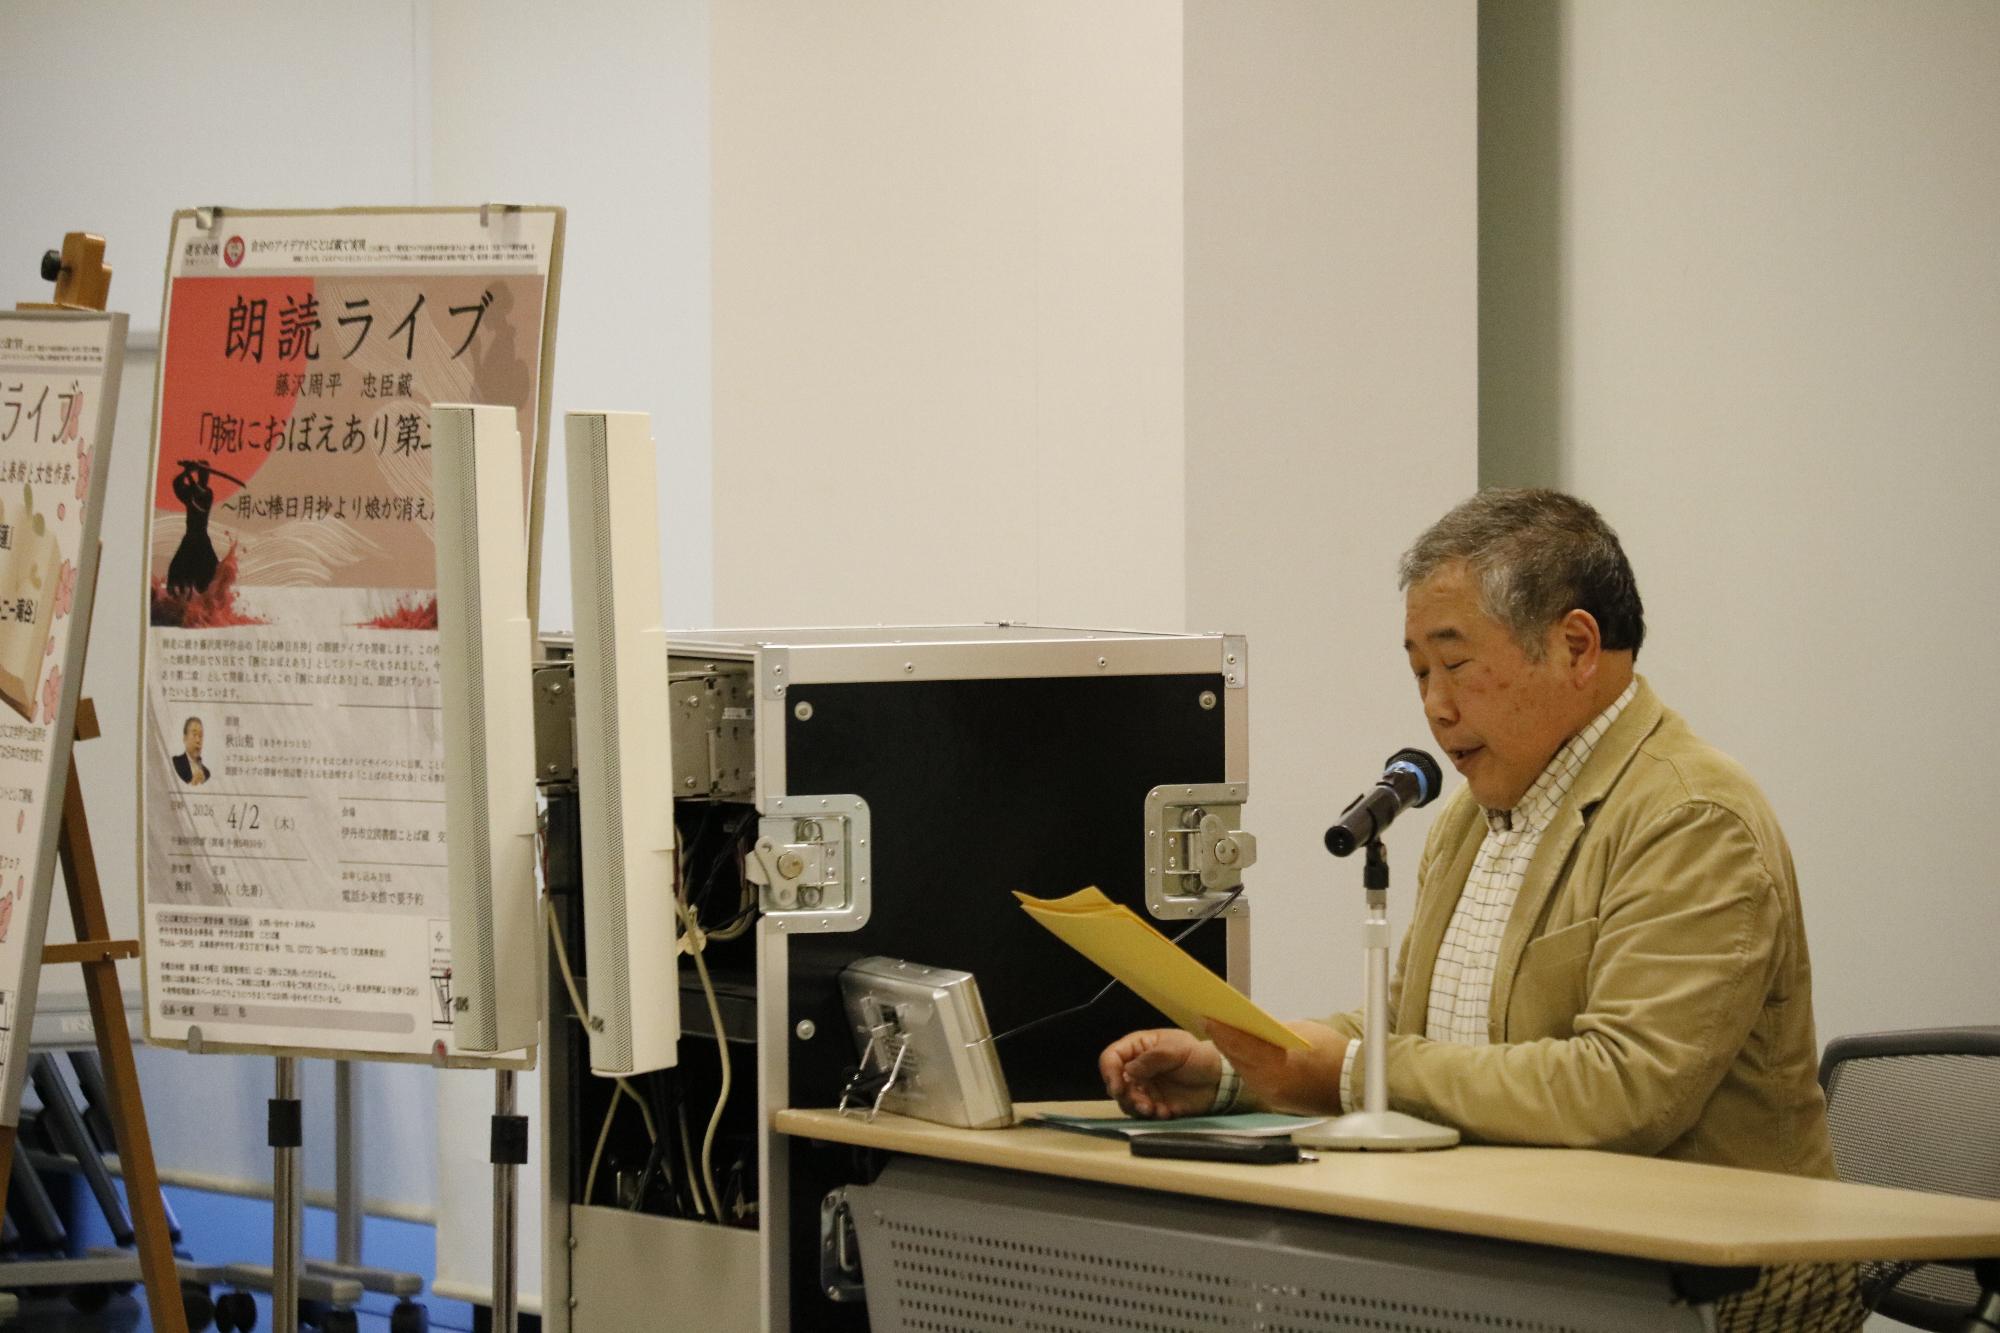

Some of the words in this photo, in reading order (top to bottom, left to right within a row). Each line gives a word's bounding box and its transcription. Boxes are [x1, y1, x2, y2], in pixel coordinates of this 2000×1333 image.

[224, 290, 494, 363] 朗読ライブ
[275, 372, 343, 399] 藤沢周平
[360, 371, 413, 399] 忠臣蔵
[222, 494, 435, 522] ～用心棒日月抄より娘が消え
[227, 802, 260, 831] 4/2
